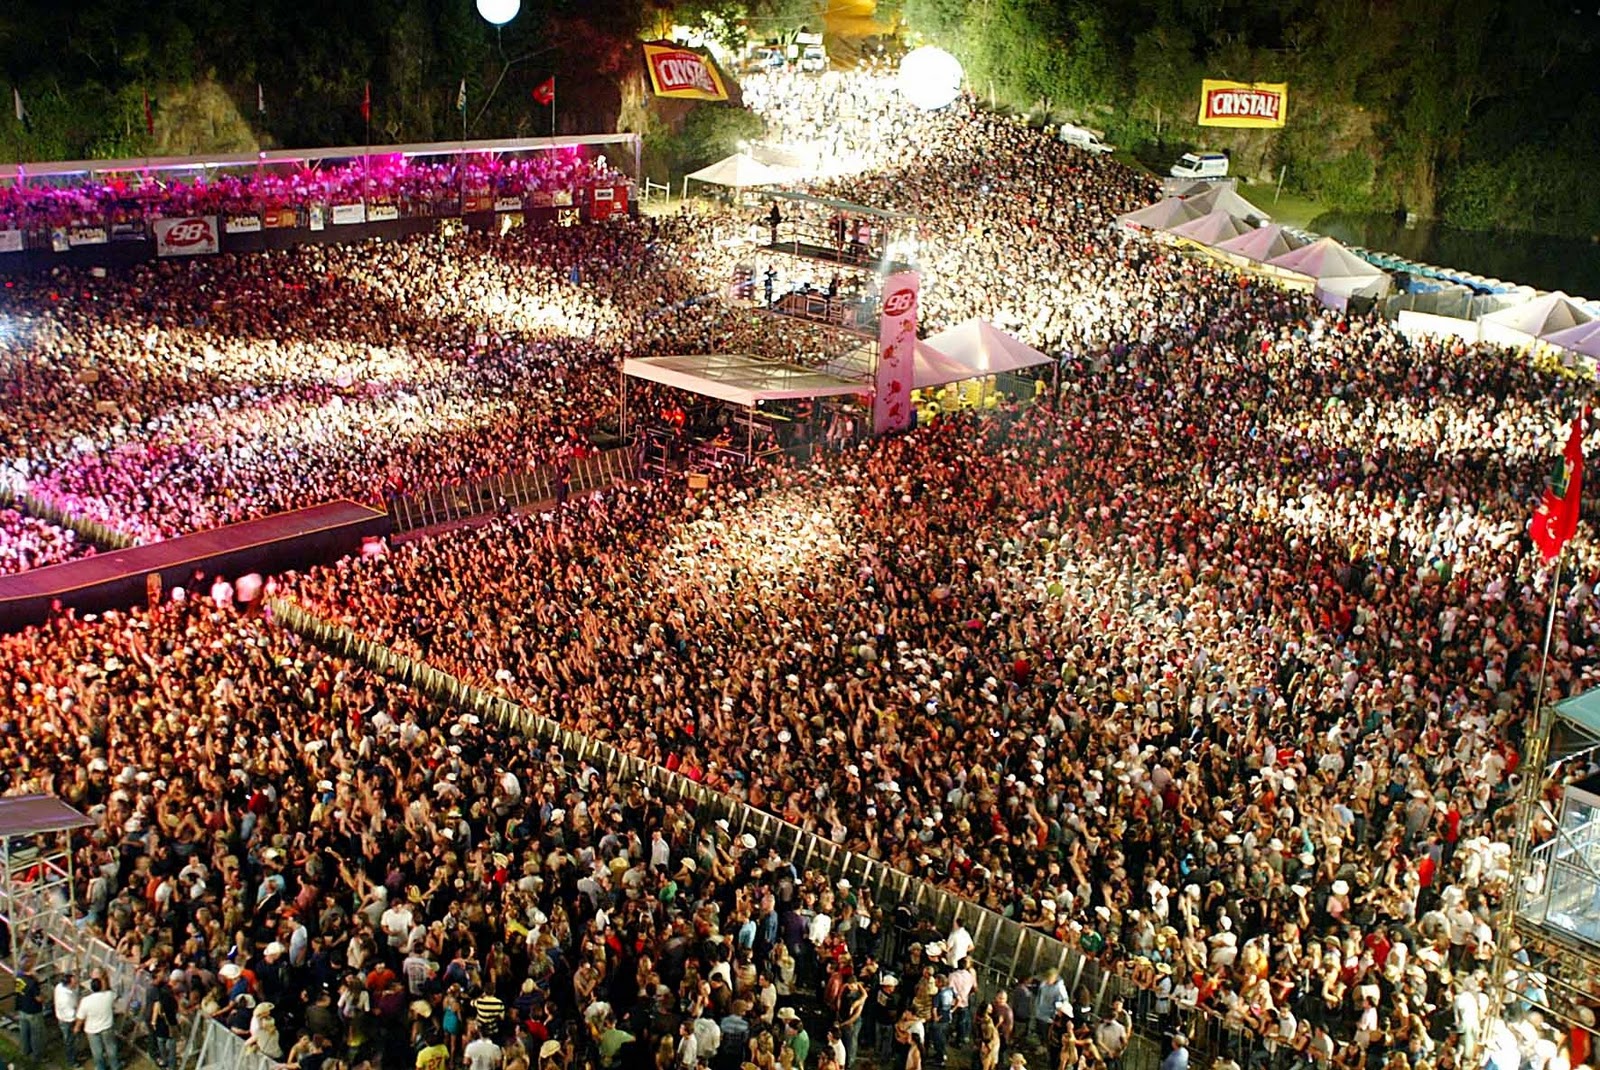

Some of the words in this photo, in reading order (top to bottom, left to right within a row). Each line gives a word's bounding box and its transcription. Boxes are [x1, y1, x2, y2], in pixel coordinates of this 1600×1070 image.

[1213, 93, 1273, 116] CRYSTAL
[171, 223, 204, 241] 98
[885, 293, 912, 312] 98
[428, 1055, 442, 1070] 27
